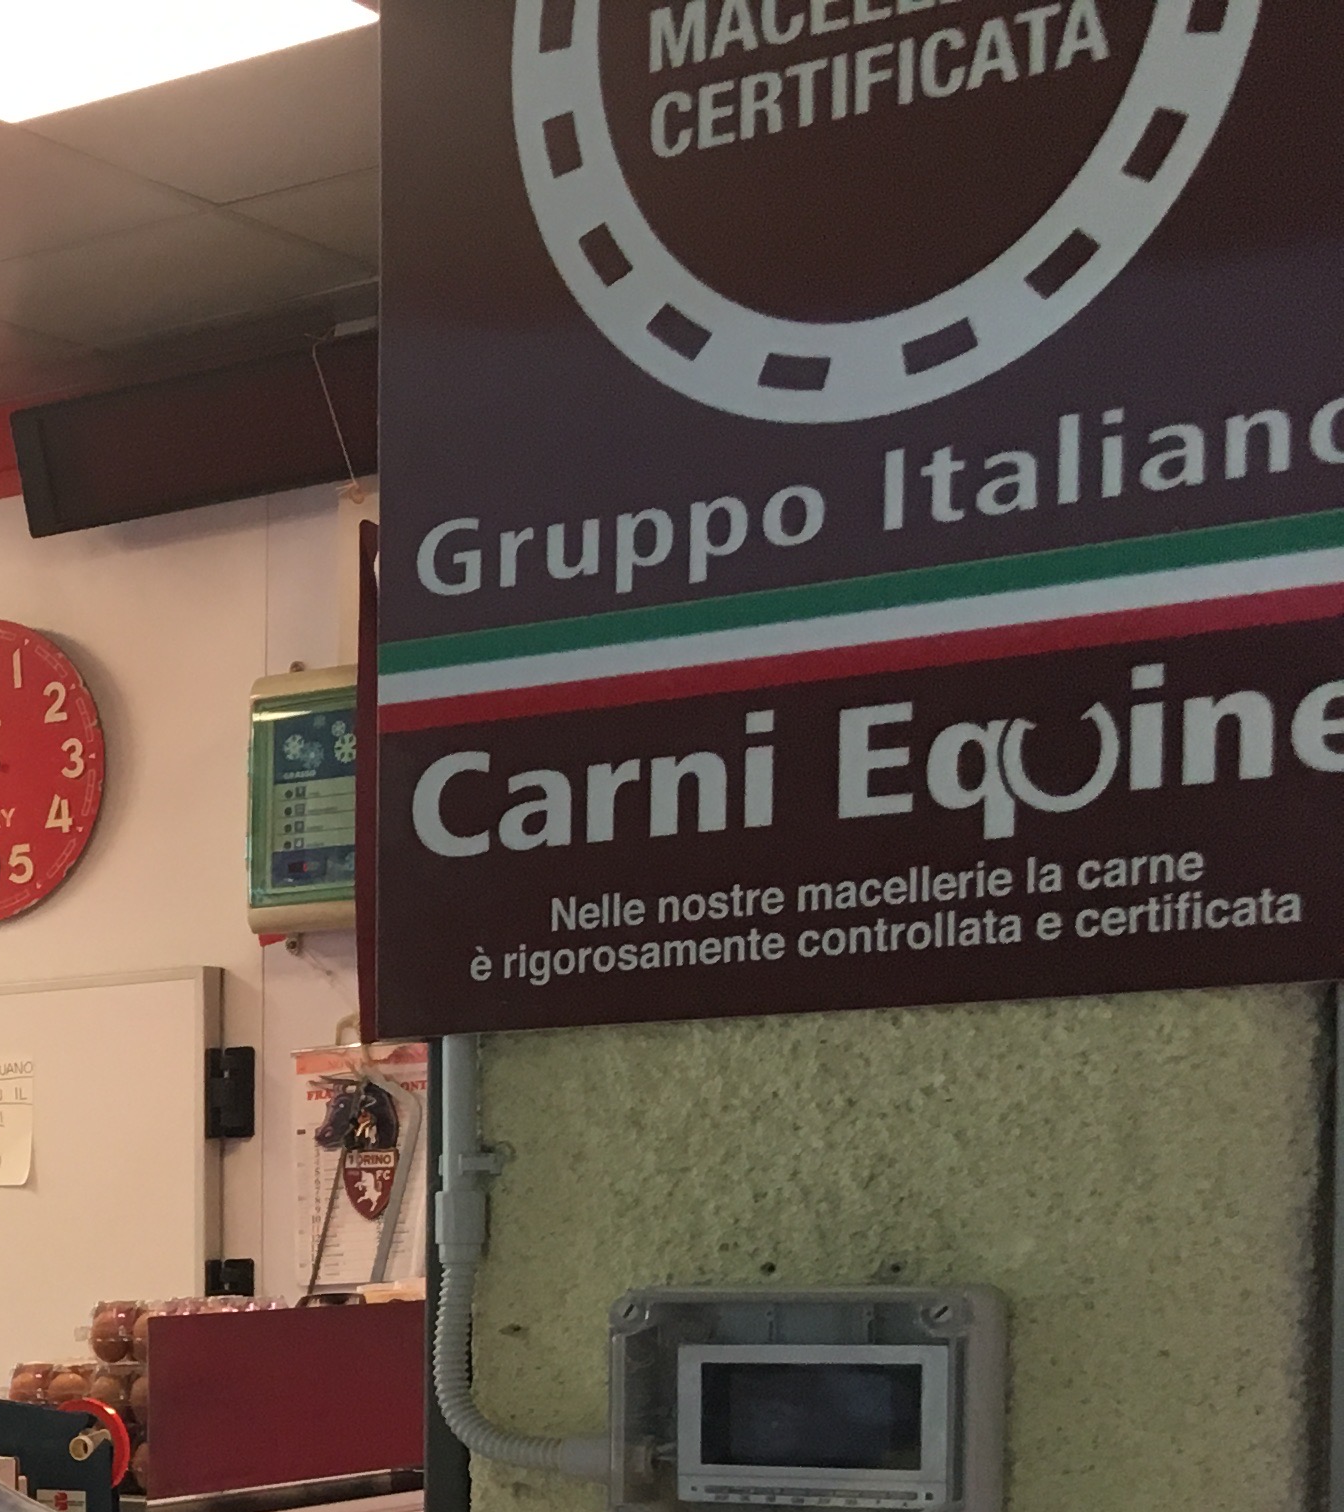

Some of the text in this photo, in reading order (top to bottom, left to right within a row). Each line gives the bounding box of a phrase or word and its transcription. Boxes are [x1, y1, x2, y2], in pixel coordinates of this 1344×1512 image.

[650, 0, 1109, 158] CERTIFICATA
[416, 484, 825, 598] Gruppo
[12, 648, 23, 689] 1
[43, 681, 68, 724] 2
[61, 738, 85, 779] 3
[412, 709, 774, 857] Carni
[45, 793, 73, 834] 4
[8, 843, 34, 884] 5
[550, 849, 1205, 932] Nelle nostre macellerie la carne
[470, 888, 1303, 986] è rigorosamente controllata e certificata
[14, 1087, 28, 1101] IL
[348, 1154, 392, 1165] TORINO
[375, 1169, 391, 1180] FC
